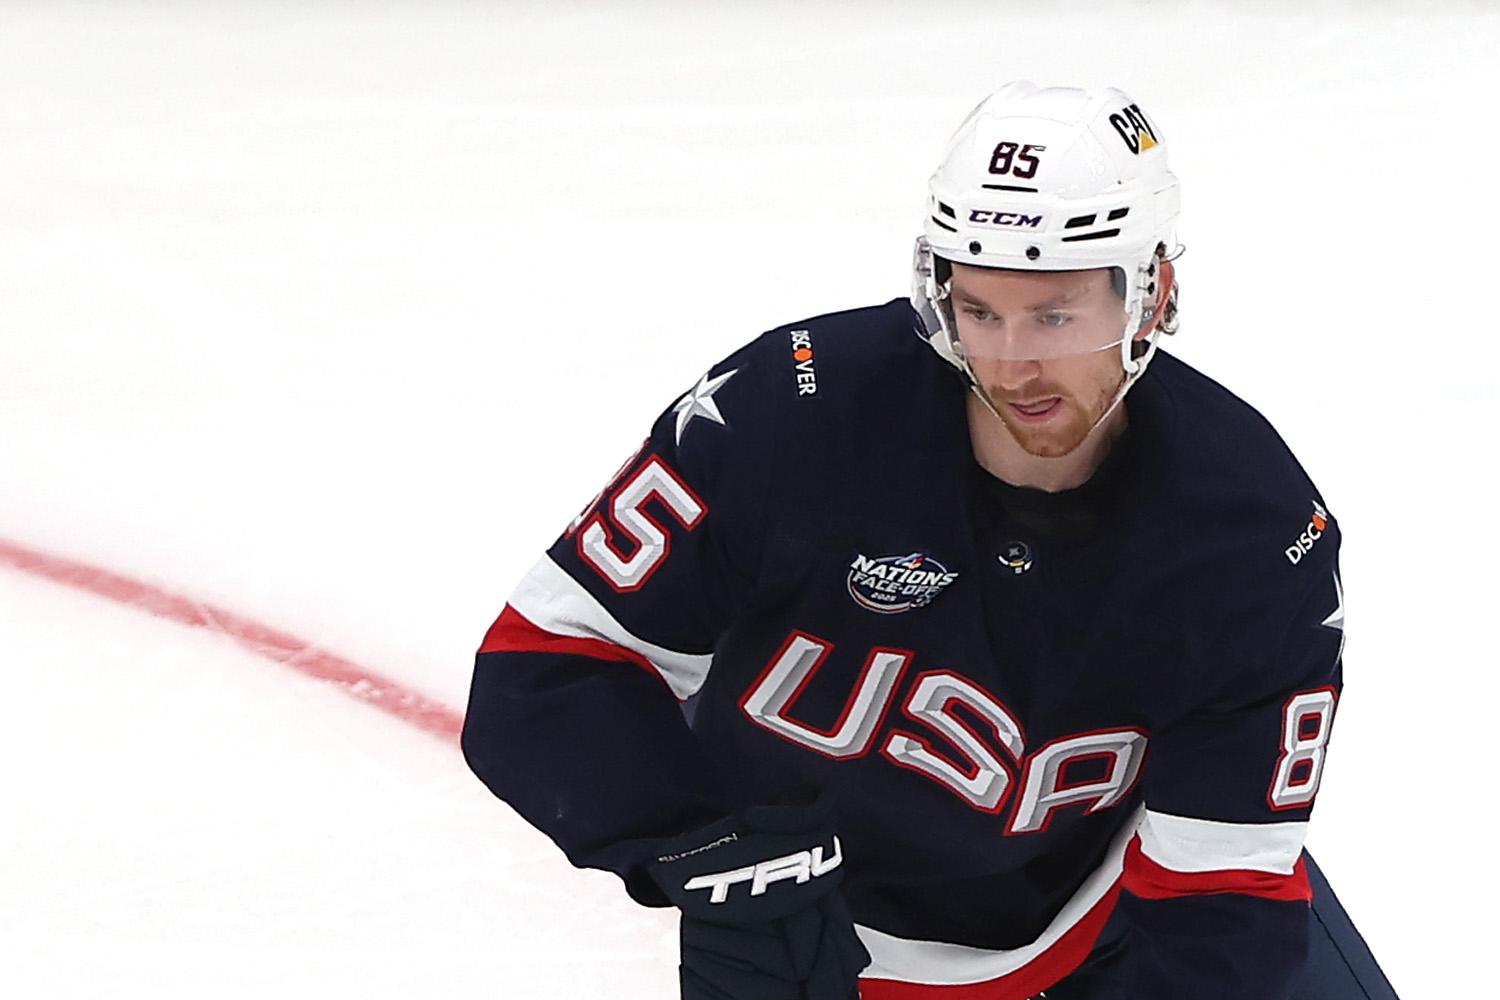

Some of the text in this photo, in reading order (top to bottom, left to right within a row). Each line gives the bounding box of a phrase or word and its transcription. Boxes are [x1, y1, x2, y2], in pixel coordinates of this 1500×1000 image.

[1108, 103, 1158, 155] CAT
[988, 141, 1046, 179] 85
[968, 209, 1042, 228] CCM
[567, 438, 708, 592] 5
[850, 553, 959, 586] NATIONS
[738, 629, 1150, 836] USA
[1266, 684, 1340, 812] 8
